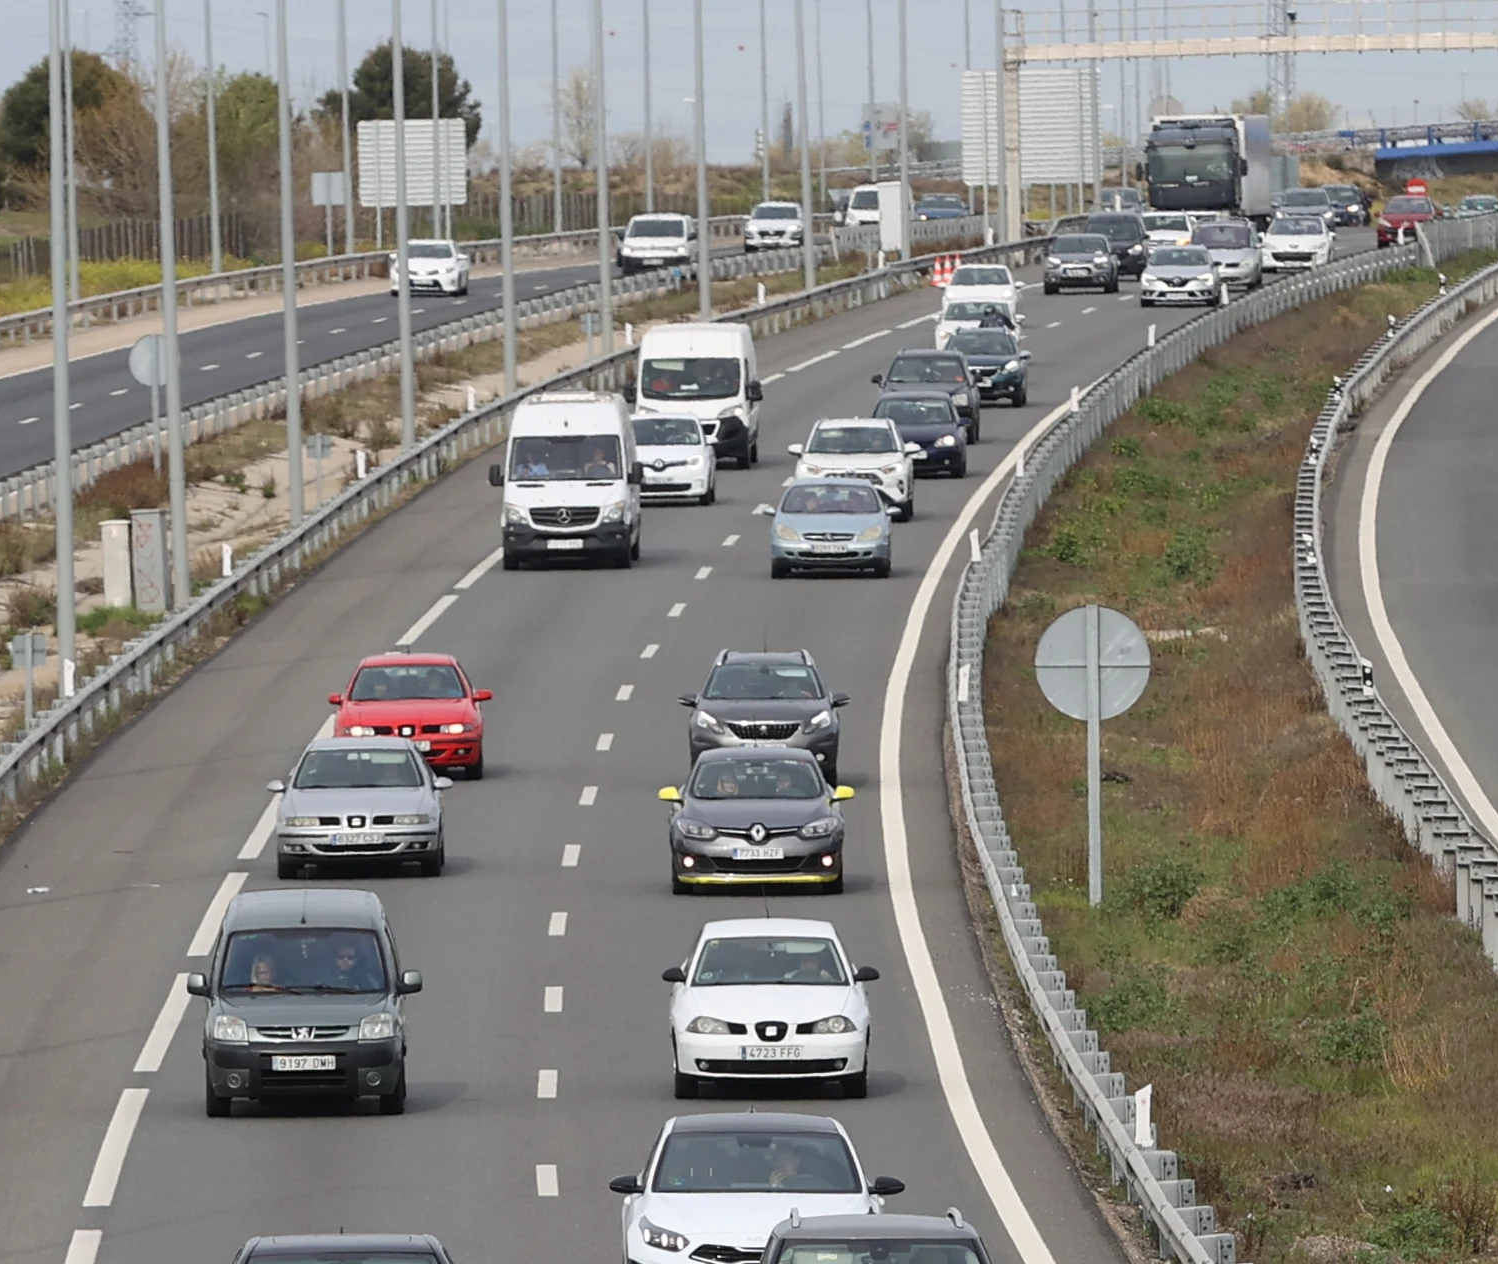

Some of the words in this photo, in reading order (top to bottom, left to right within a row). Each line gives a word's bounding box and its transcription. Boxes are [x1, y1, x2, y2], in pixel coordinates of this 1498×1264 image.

[749, 1048, 776, 1058] 4723
[780, 1047, 801, 1058] FFG
[280, 1059, 308, 1069] 9197
